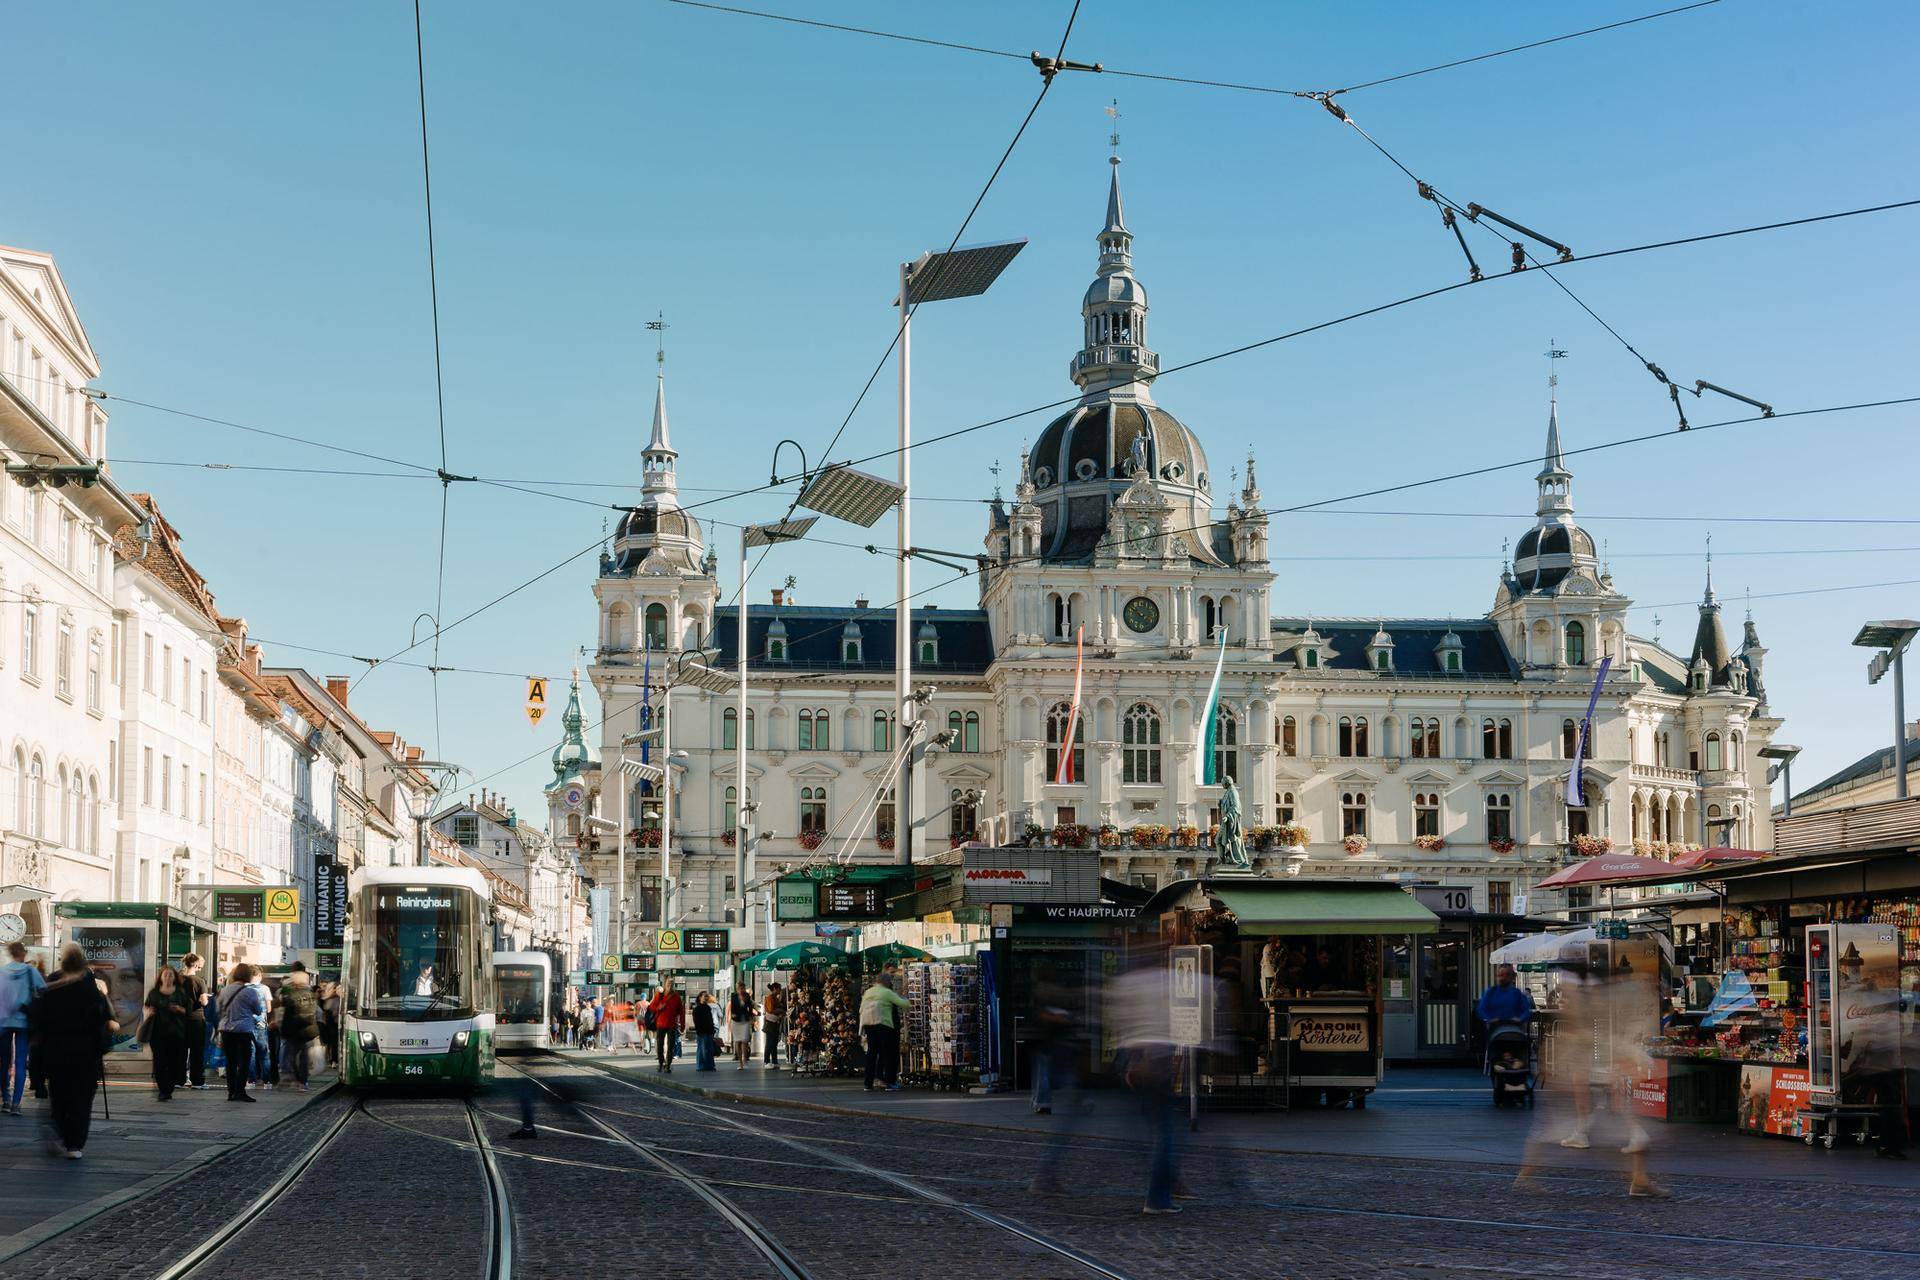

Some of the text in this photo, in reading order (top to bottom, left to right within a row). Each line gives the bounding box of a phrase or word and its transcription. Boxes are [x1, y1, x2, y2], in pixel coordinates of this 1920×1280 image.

[528, 681, 545, 702] A
[531, 708, 542, 719] 20
[966, 869, 1026, 881] MORAWA
[317, 865, 330, 931] HUMANIC
[379, 896, 452, 909] 4 Reininghaus
[1444, 892, 1467, 910] 10
[1047, 907, 1136, 918] WC HAUPTPLATZ
[96, 938, 125, 948] Jobs?
[1300, 1022, 1361, 1031] MARONI
[405, 1066, 423, 1075] 546
